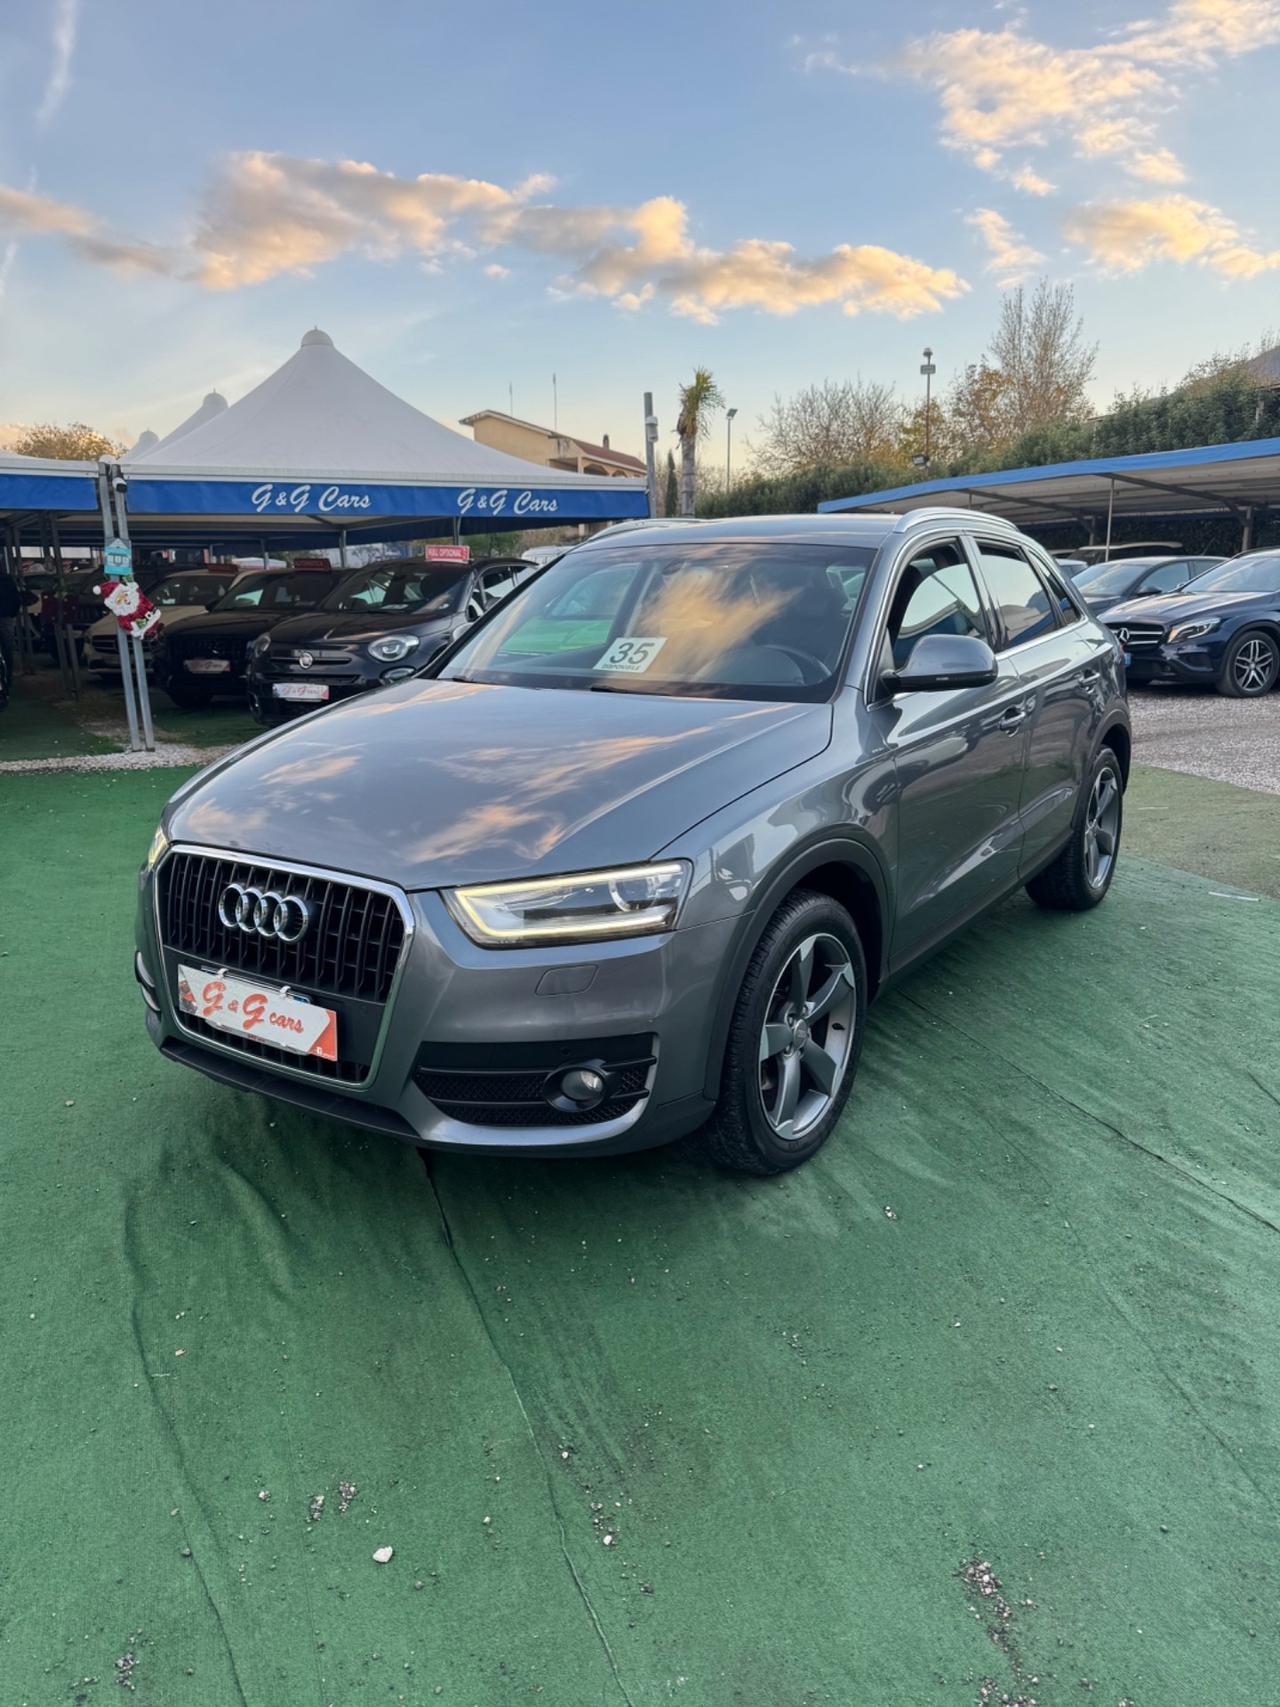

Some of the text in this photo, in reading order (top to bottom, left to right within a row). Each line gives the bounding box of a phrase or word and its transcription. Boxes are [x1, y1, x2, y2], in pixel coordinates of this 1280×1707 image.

[318, 486, 372, 511] Cars
[513, 491, 559, 514] Cars
[609, 642, 655, 664] 35
[269, 1012, 304, 1033] cars
